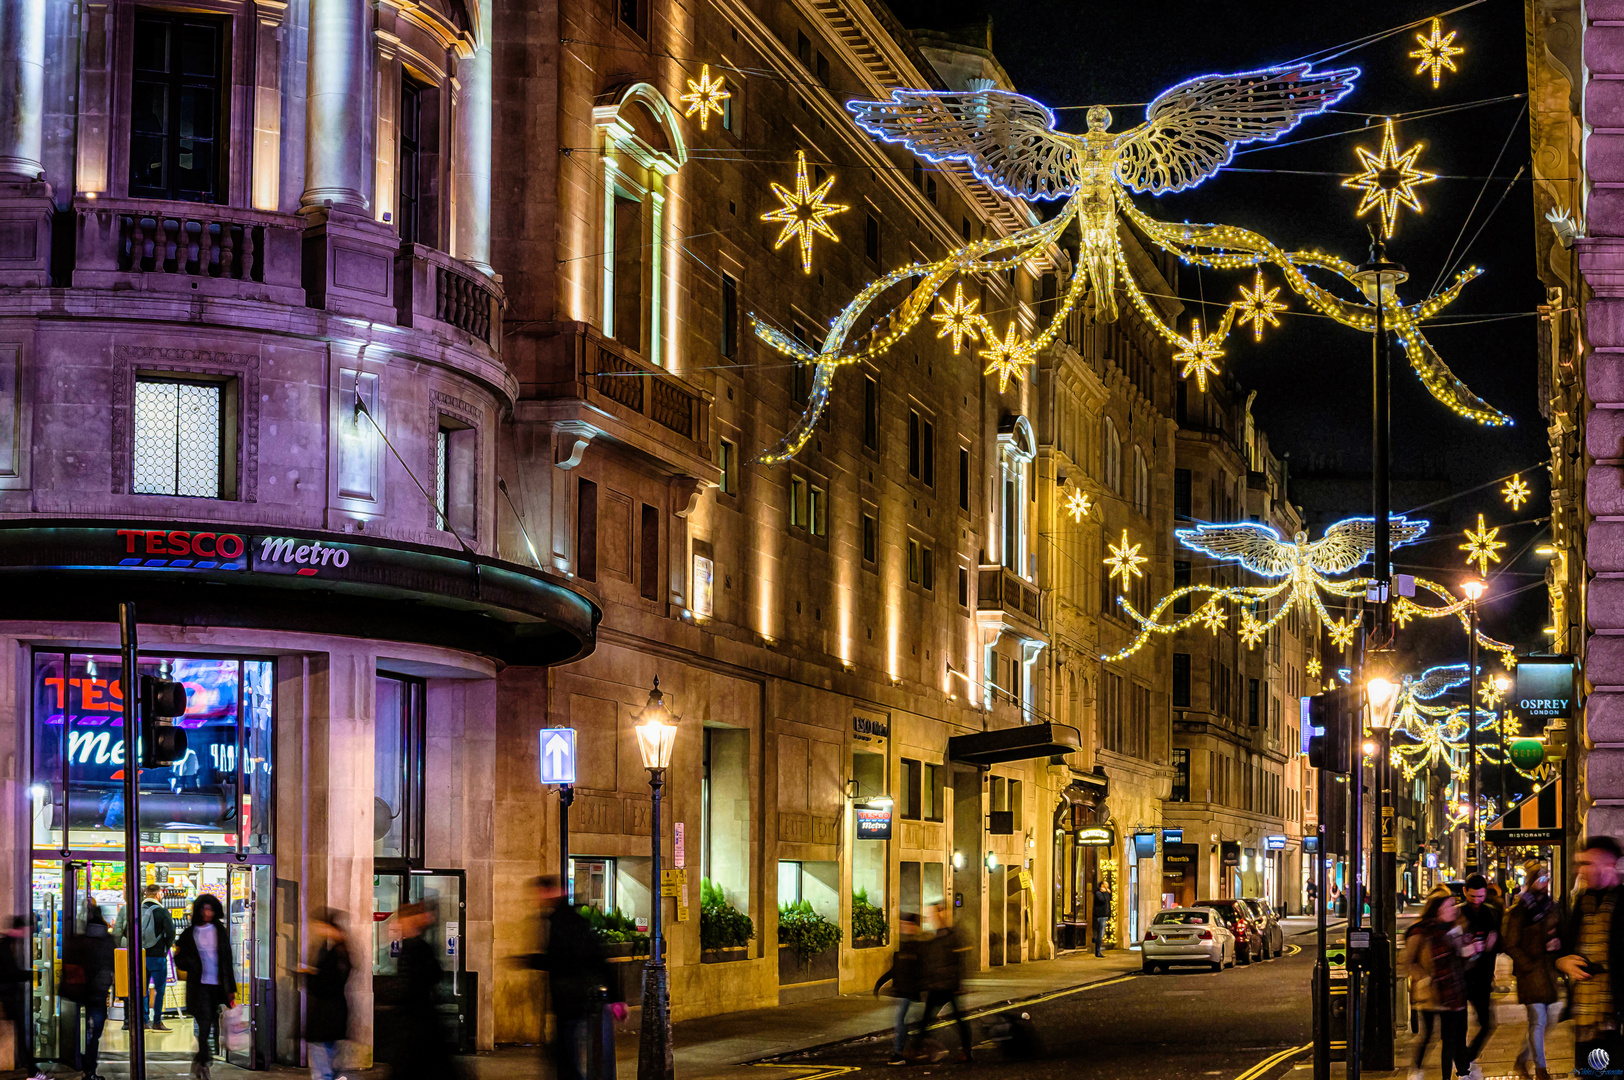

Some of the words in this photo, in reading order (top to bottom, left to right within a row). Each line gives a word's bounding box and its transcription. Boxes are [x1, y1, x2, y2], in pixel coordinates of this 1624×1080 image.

[117, 529, 244, 559] TESCO
[260, 537, 350, 568] Metro
[1520, 699, 1569, 709] OSPREY
[580, 803, 608, 825] EXIT
